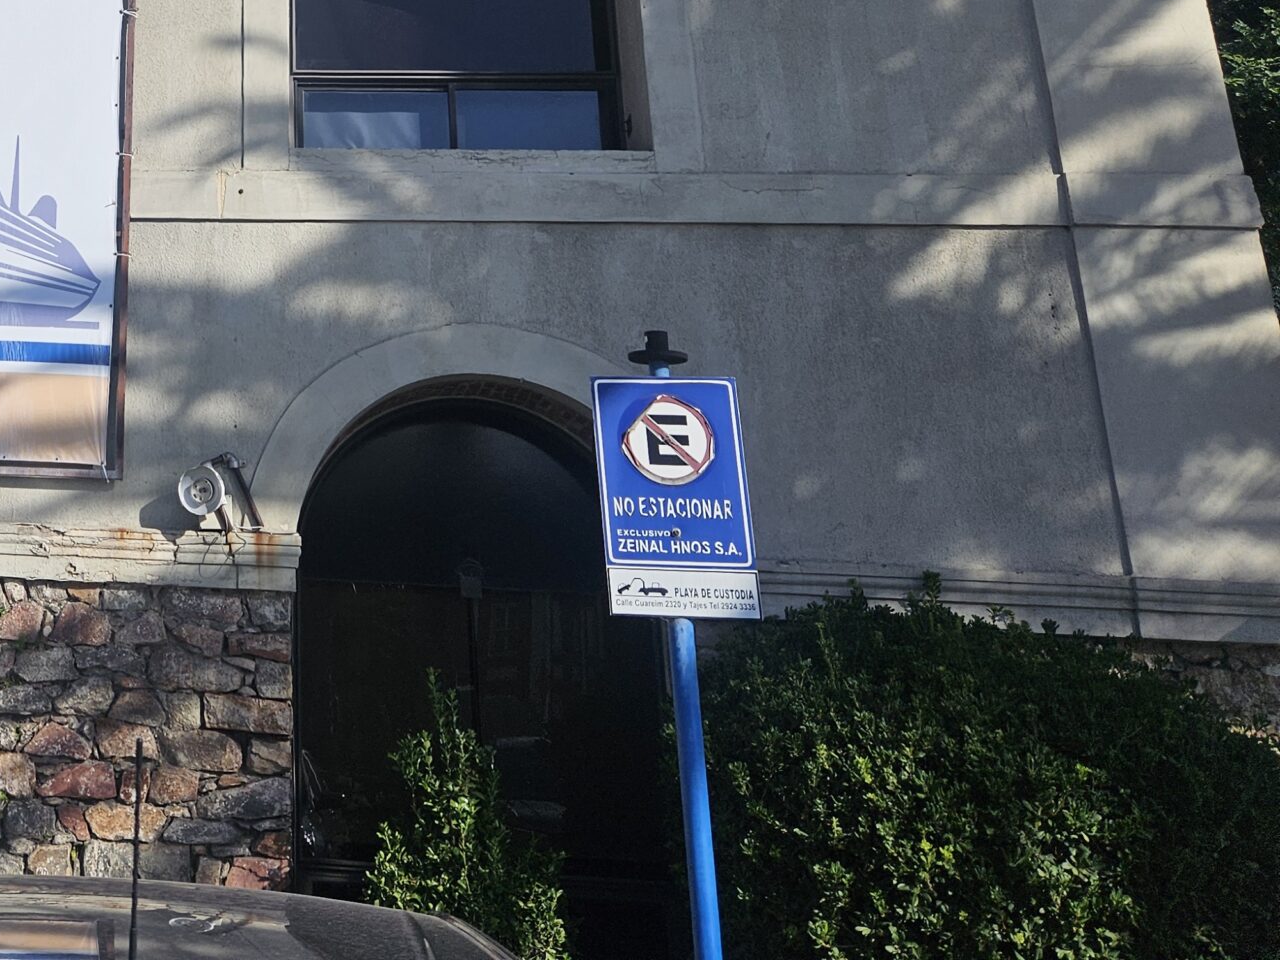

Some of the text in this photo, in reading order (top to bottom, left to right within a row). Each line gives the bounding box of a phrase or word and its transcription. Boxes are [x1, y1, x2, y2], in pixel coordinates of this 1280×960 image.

[613, 496, 733, 519] NO ESTACIONAR
[617, 528, 671, 537] EXCLUSIVO
[618, 538, 742, 556] ZEINAL HNOS S.A.
[674, 587, 754, 600] PLAYA DE CUSTODIA
[616, 598, 633, 607] Calle
[709, 602, 720, 610] Tel
